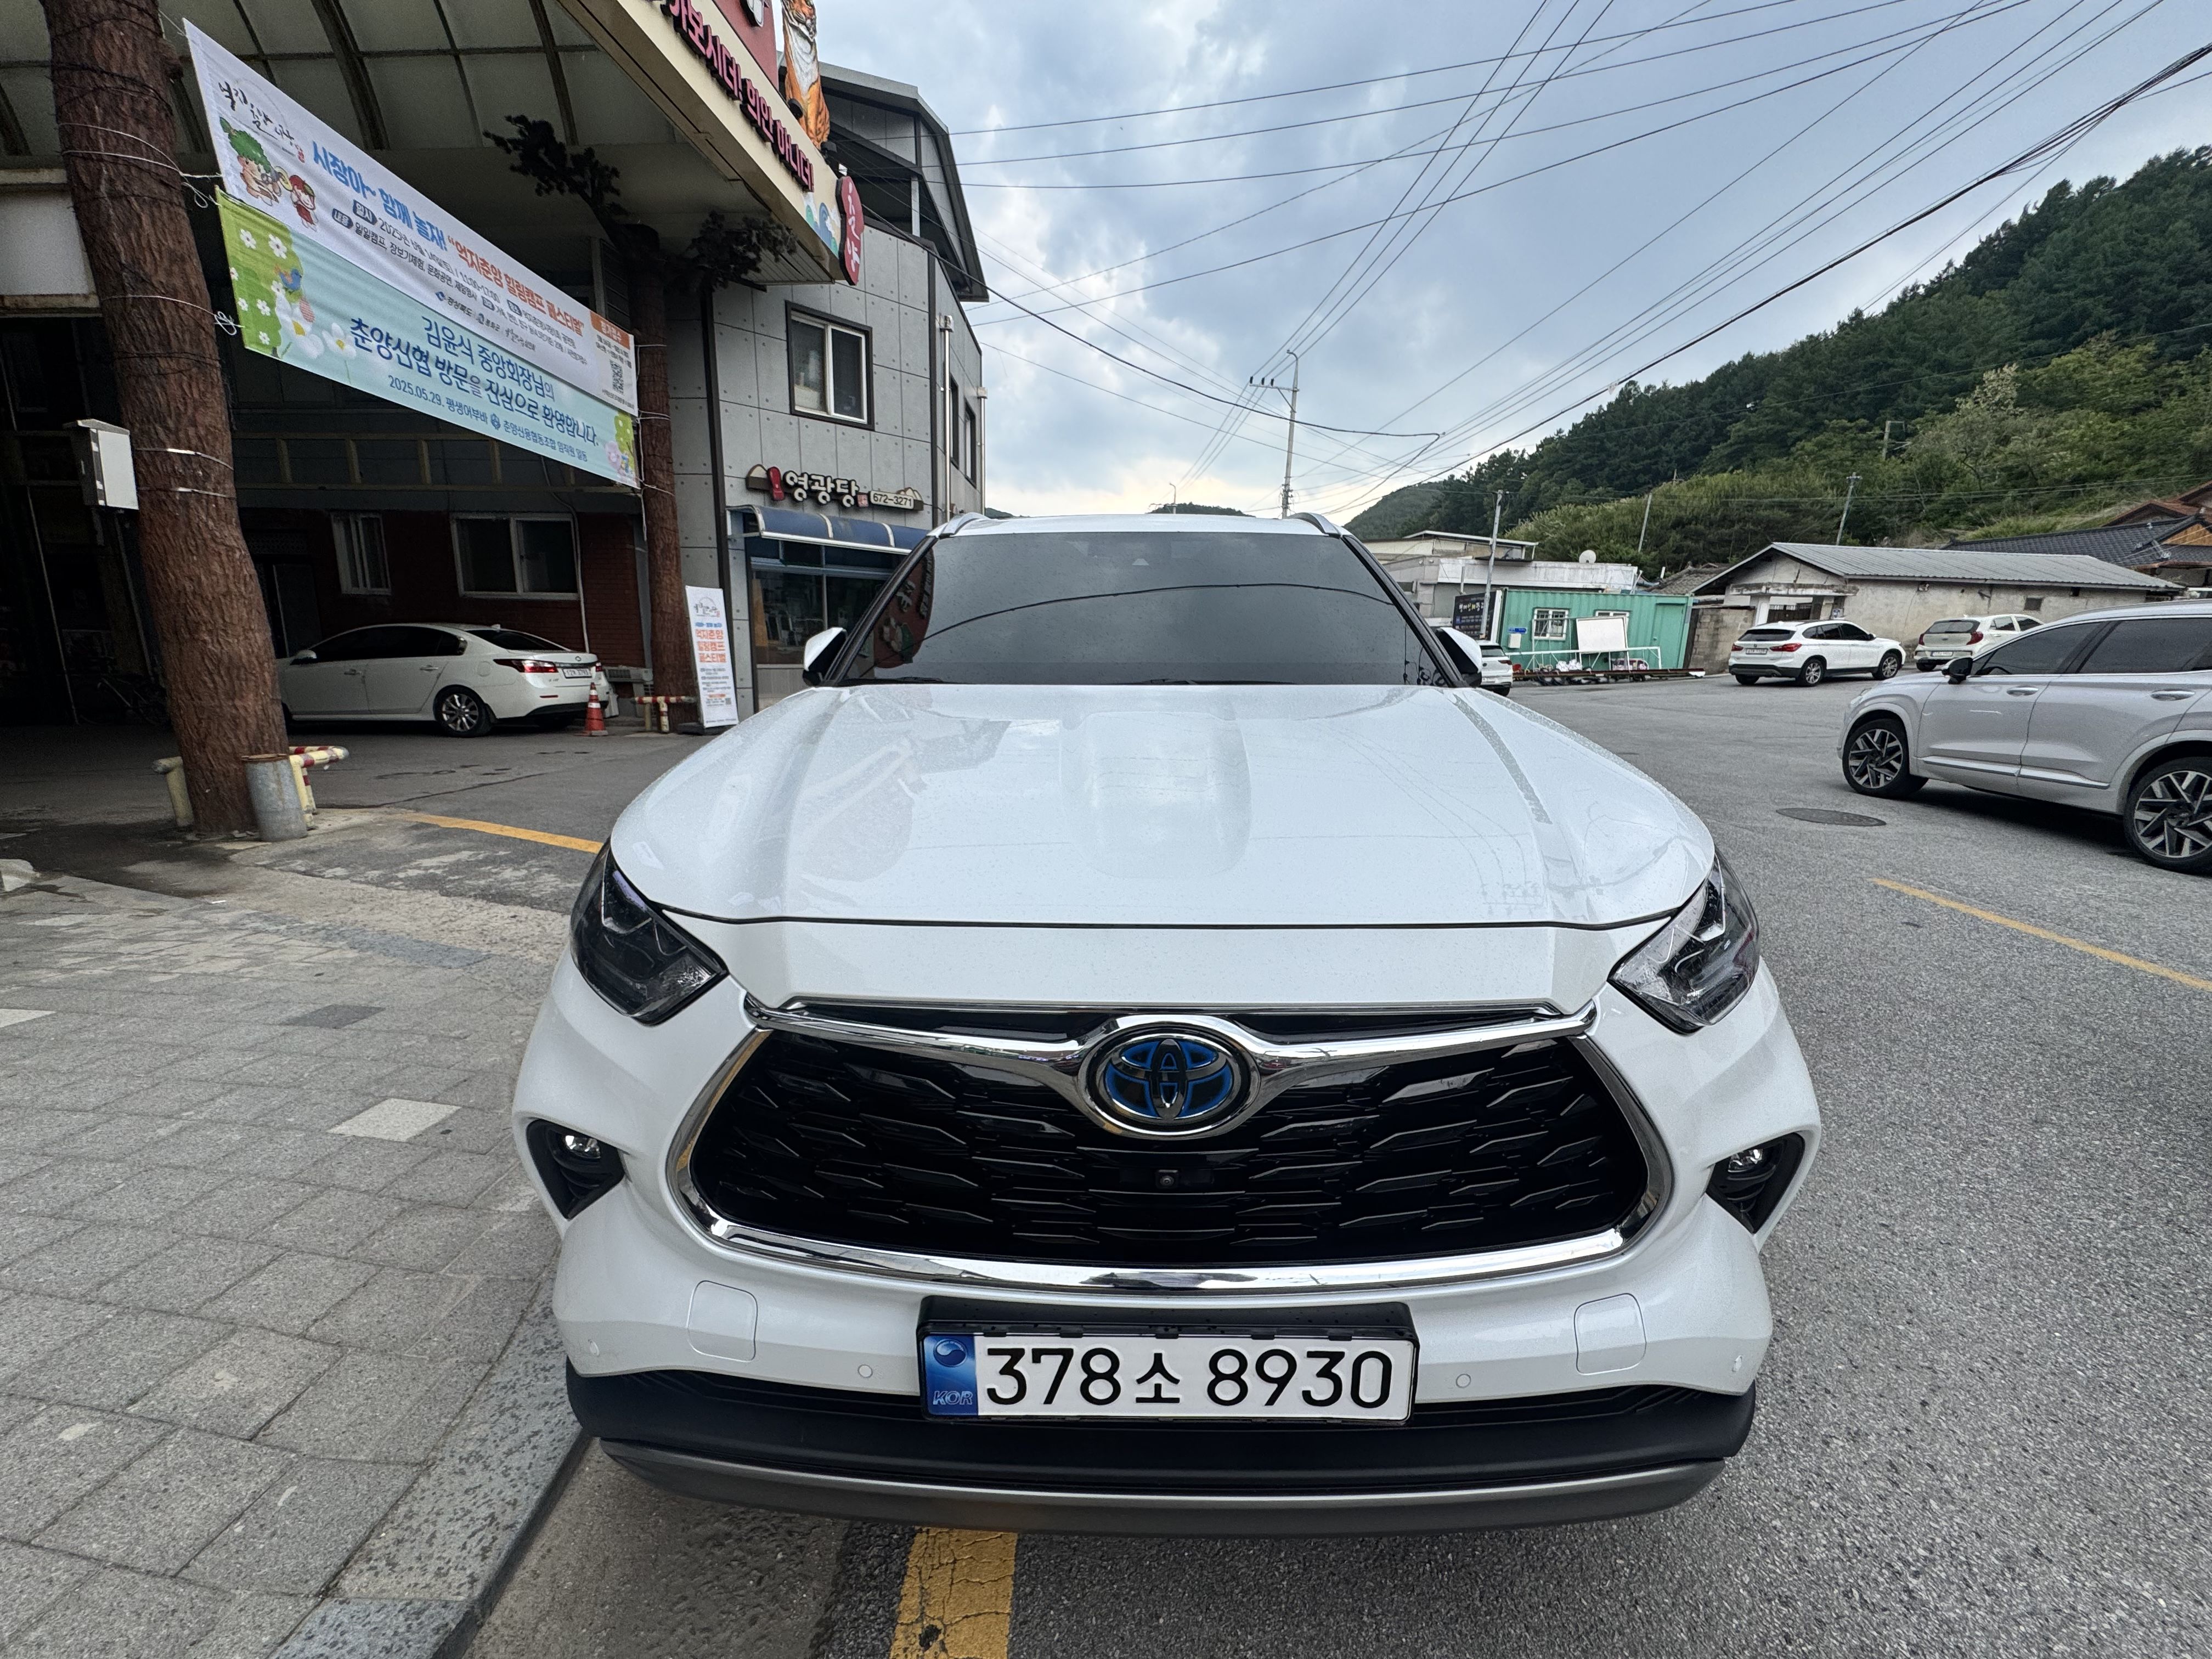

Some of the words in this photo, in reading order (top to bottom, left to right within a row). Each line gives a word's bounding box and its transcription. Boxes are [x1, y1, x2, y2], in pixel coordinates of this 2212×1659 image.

[313, 140, 376, 200] 시장아~
[378, 188, 413, 230] 함께
[413, 210, 448, 251] 놀자!
[504, 273, 546, 314] 힐링캠프
[350, 318, 432, 377] 춘양신협
[435, 356, 482, 398] 방문을
[484, 379, 540, 421] 진심으로
[542, 404, 599, 447] 환영합니다.
[421, 316, 474, 365] 김윤식
[477, 344, 555, 402] 중앙회장님의
[388, 375, 445, 408] 2025.05.29.
[445, 397, 488, 425] 평생어부바
[785, 471, 859, 508] 영광당
[872, 493, 913, 507] 672-3271
[933, 1391, 974, 1406] KOR
[986, 1347, 1181, 1407] 378소
[1207, 1348, 1393, 1409] 8930
